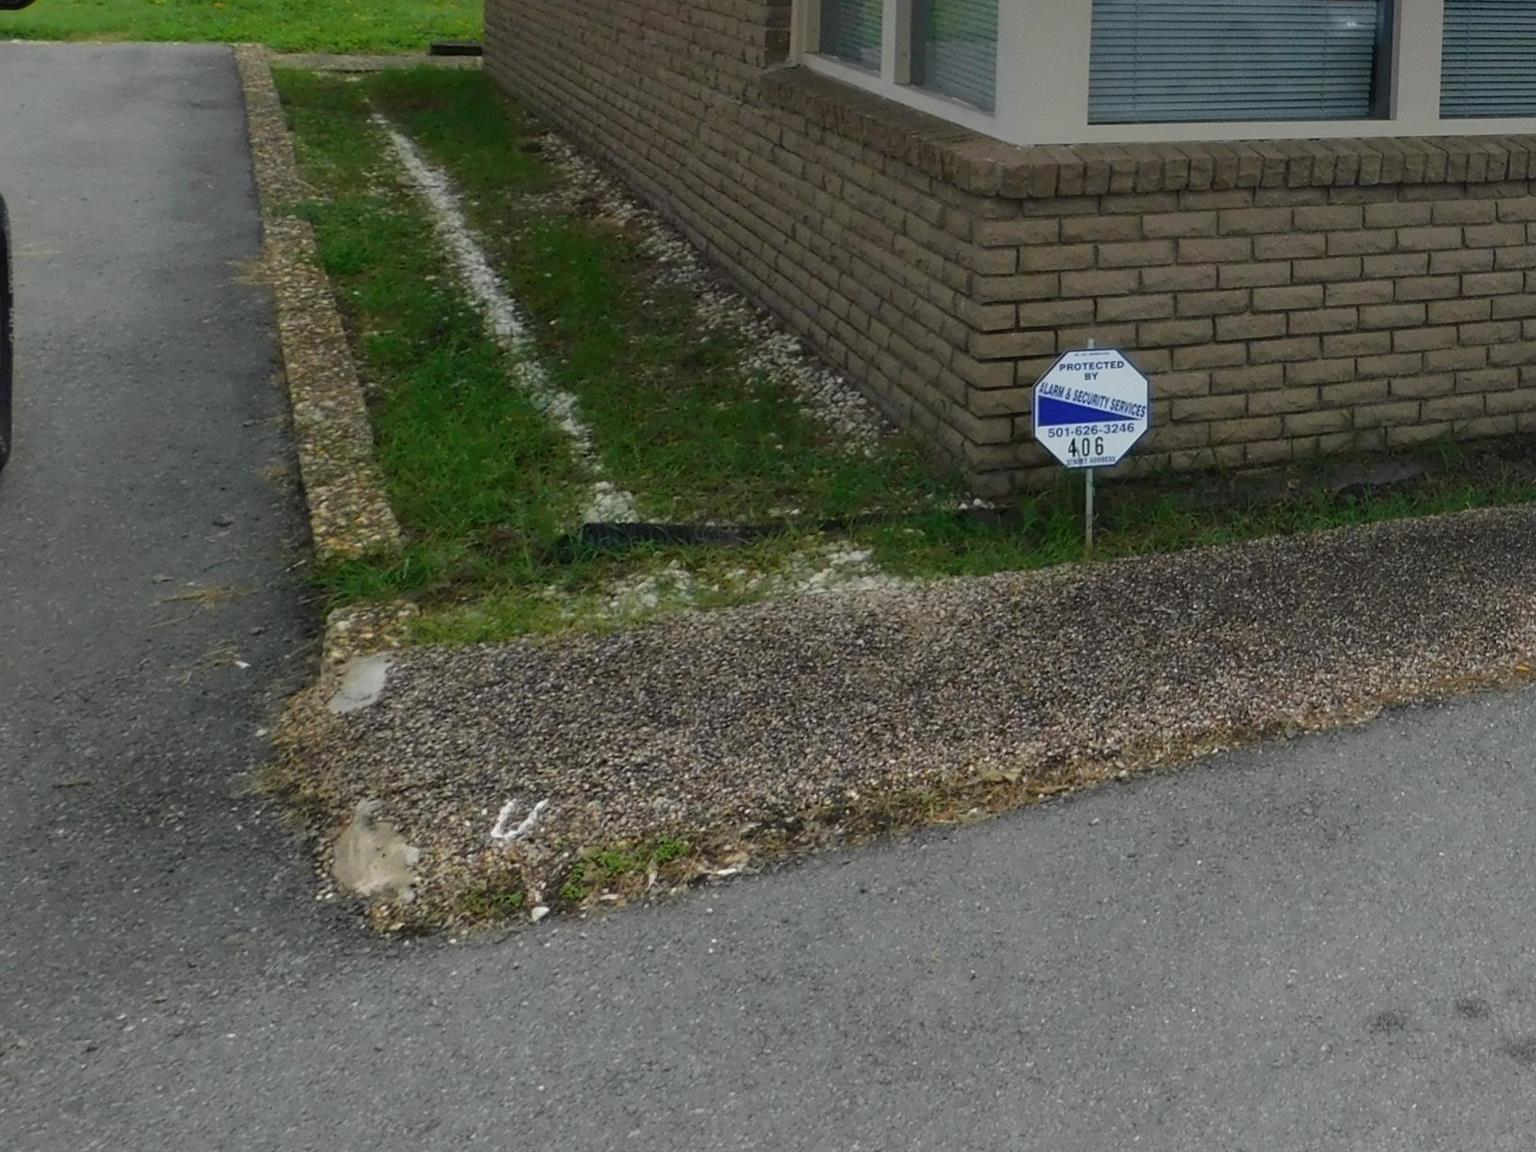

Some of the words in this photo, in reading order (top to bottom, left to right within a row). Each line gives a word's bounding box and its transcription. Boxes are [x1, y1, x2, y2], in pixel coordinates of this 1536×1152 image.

[1059, 361, 1124, 371] PROTECTED
[1084, 373, 1098, 381] BY
[1039, 382, 1065, 397] ALARM
[1065, 388, 1072, 400] &
[1072, 389, 1110, 409] SECURITY
[1110, 398, 1147, 418] SERVICES
[1048, 423, 1135, 438] 501-626-3246
[1068, 437, 1104, 457] 406
